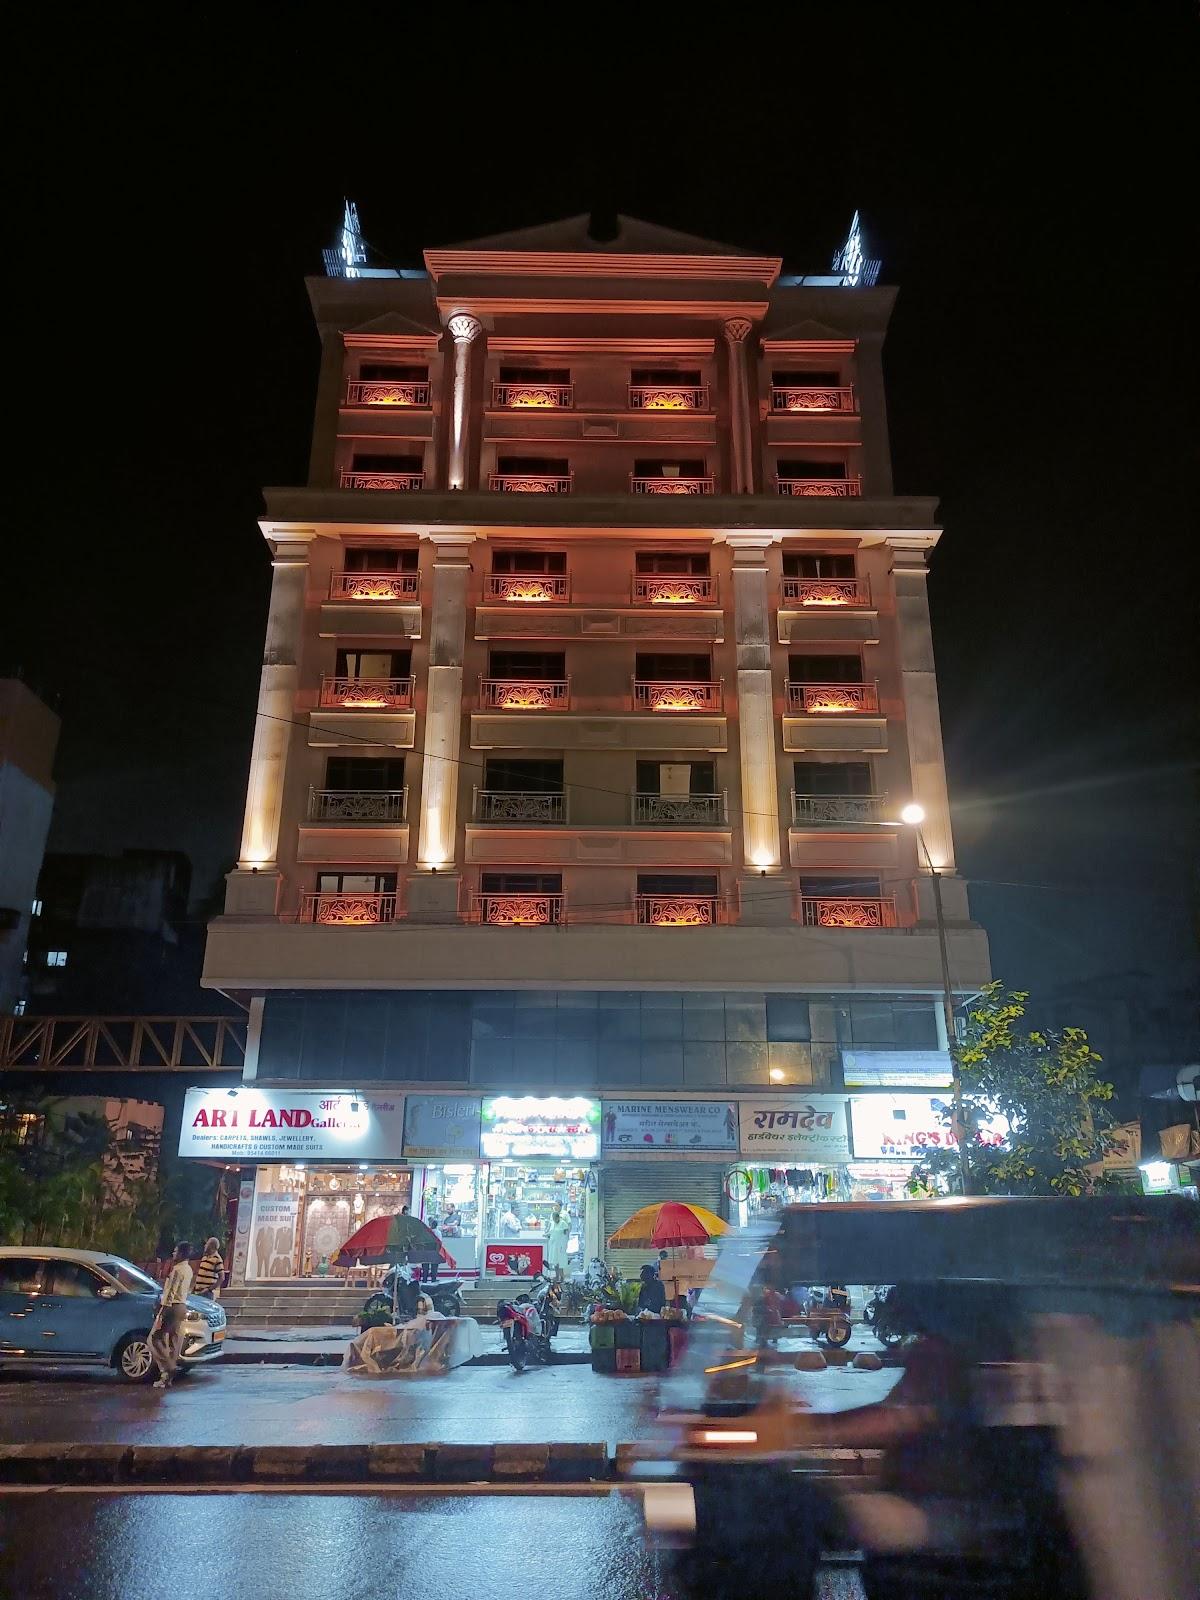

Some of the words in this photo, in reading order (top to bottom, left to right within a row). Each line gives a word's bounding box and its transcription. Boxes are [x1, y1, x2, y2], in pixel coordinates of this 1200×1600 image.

[617, 1105, 652, 1113] MARINE
[654, 1105, 707, 1114] MENSWEAR
[708, 1106, 721, 1114] CO
[248, 1109, 312, 1128] LAND
[753, 1105, 835, 1131] रामदेव
[882, 1131, 941, 1145] KNG'S
[260, 1205, 291, 1213] CUSTOM
